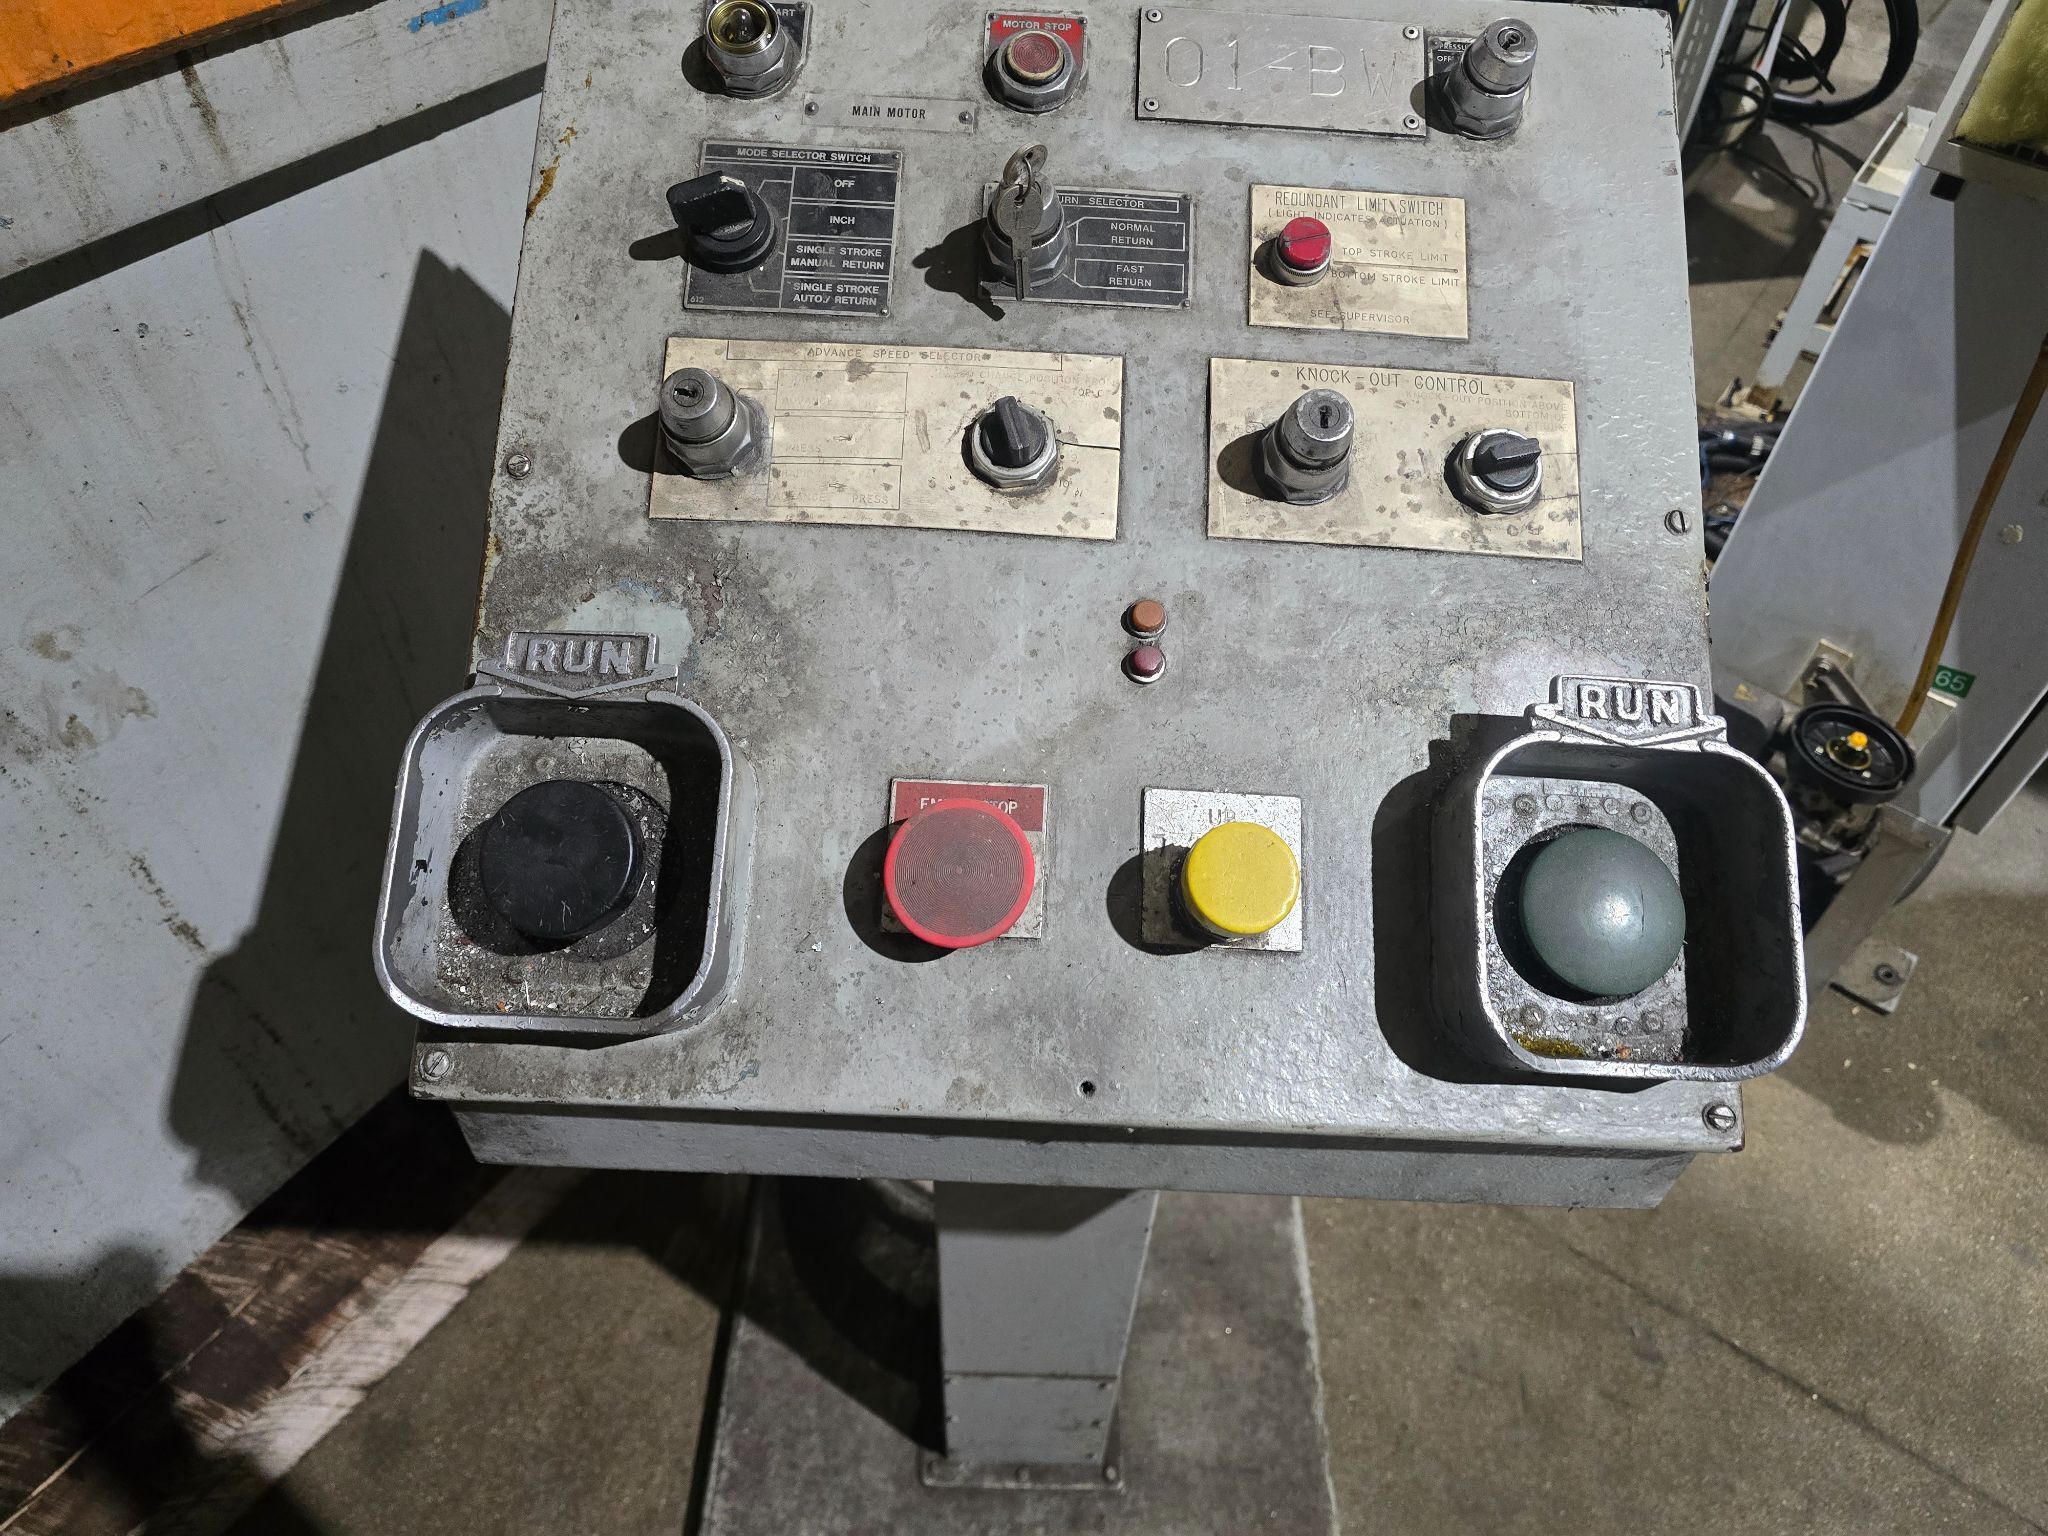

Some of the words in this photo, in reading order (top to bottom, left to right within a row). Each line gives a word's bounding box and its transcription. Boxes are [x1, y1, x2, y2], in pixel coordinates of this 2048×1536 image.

[776, 8, 796, 17] ART
[1002, 20, 1040, 29] MOTOR
[1044, 22, 1072, 31] STOP
[1439, 41, 1467, 51] PRESSU
[852, 105, 881, 117] MAIN
[886, 107, 926, 119] MOTOR
[737, 147, 767, 157] MODE
[771, 149, 827, 160] SELECTOR
[830, 152, 872, 163] SWITCH
[834, 179, 855, 188] OFF
[1058, 195, 1079, 205] URN
[1088, 197, 1145, 208] SELECTOR
[1275, 191, 1346, 209] REDUNDANT
[1357, 196, 1388, 212] LIMIT
[1399, 199, 1444, 216] SWITCH
[829, 215, 855, 225] INCH
[1314, 211, 1371, 223] INDICATES
[1110, 222, 1156, 233] NORMAL
[1111, 236, 1154, 246] RETURN
[796, 245, 836, 255] SINGLE
[839, 247, 882, 257] STROKE
[1342, 247, 1362, 256] TOP
[1369, 249, 1414, 260] STROKE
[1420, 253, 1449, 262] LIMIT
[790, 257, 836, 268] MANUAL
[842, 260, 885, 270] RETURN
[1116, 264, 1145, 273] FAST
[1109, 277, 1152, 287] RETURN
[1331, 270, 1376, 281] BOTTOM
[1381, 274, 1426, 285] STROKE
[1431, 278, 1460, 287] LIMIT
[793, 282, 833, 292] SINGLE
[836, 284, 879, 294] STROKE
[834, 295, 877, 306] RETURN
[1310, 309, 1332, 319] SEE
[1339, 311, 1410, 324] SUPERVISOR
[807, 347, 862, 358] ADVANCE
[873, 349, 910, 359] SPEED
[921, 351, 981, 362] SELECTOR
[1414, 375, 1490, 396] CONTROL
[525, 638, 631, 675] RUN
[1935, 670, 1967, 692] 65
[1578, 684, 1681, 727] RUN
